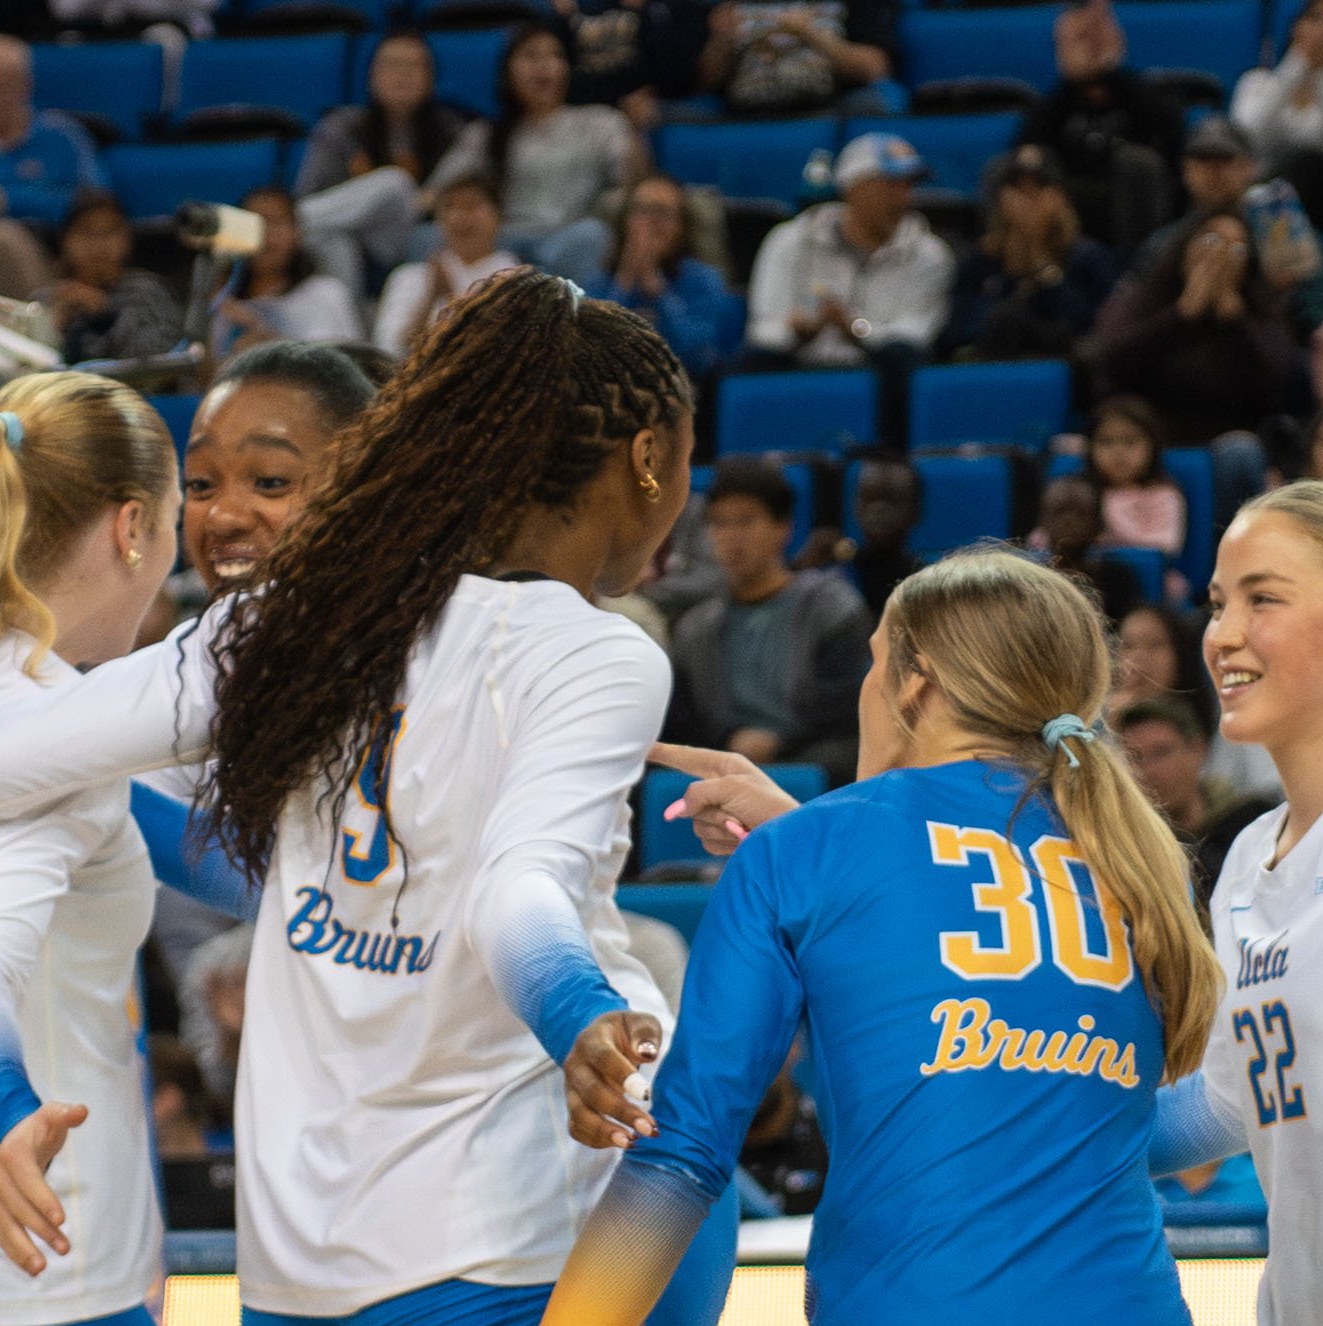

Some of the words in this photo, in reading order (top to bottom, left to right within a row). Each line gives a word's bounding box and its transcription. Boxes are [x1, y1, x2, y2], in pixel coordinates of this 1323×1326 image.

[286, 886, 441, 975] Bruins
[926, 820, 1134, 992] 30
[920, 997, 1140, 1089] Bruins
[1232, 998, 1309, 1129] 22
